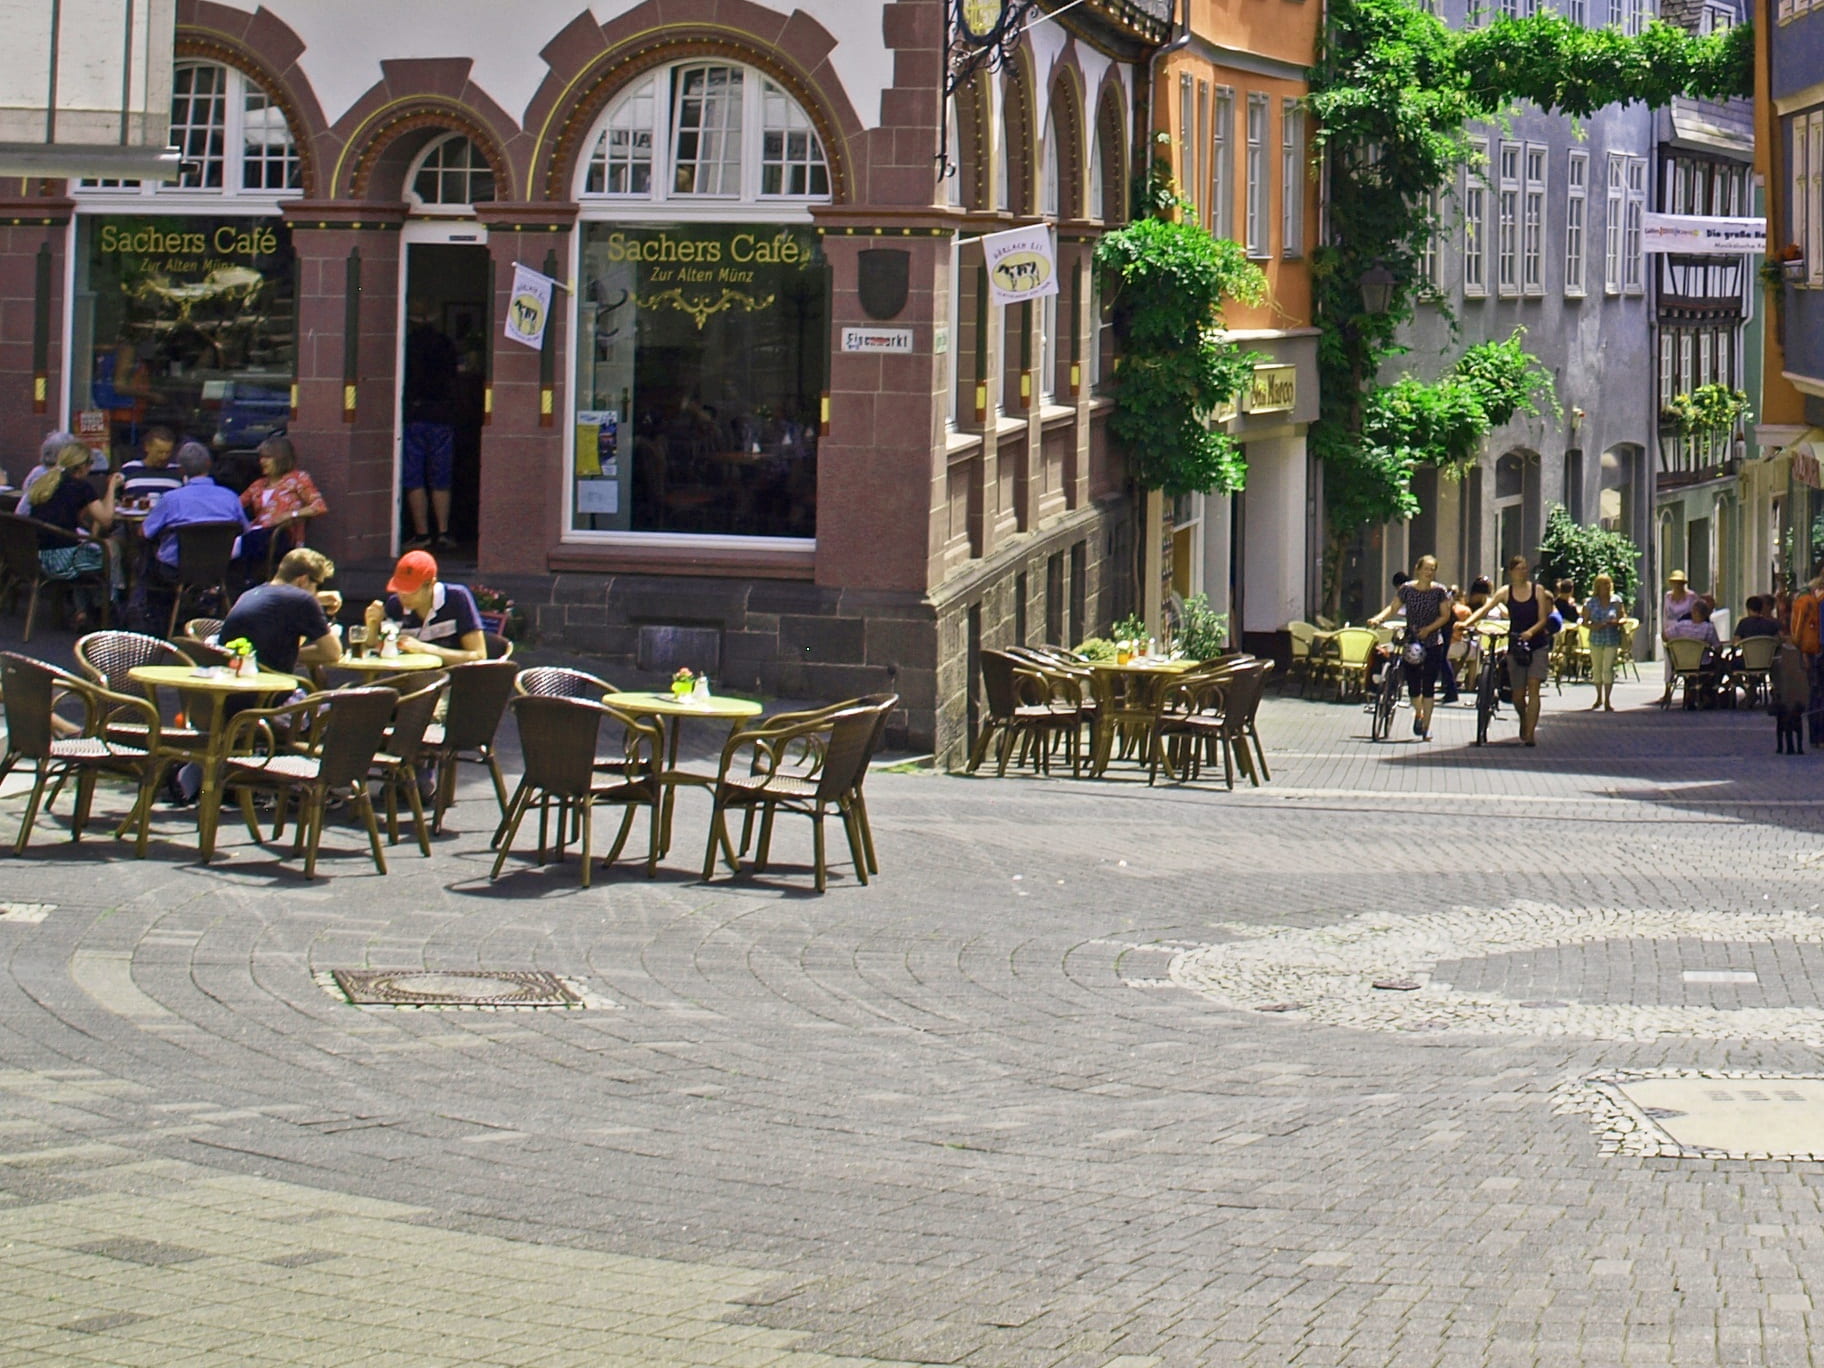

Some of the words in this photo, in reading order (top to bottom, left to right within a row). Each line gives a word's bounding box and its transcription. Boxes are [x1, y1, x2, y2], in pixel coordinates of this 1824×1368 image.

[101, 225, 206, 254] Sachers
[214, 226, 277, 254] Café
[607, 232, 722, 262] Sachers
[730, 233, 799, 262] Café
[140, 258, 162, 272] Zur
[165, 258, 197, 272] Alten
[651, 267, 673, 281] Zur
[678, 268, 713, 281] Alten
[719, 269, 755, 282] Münz
